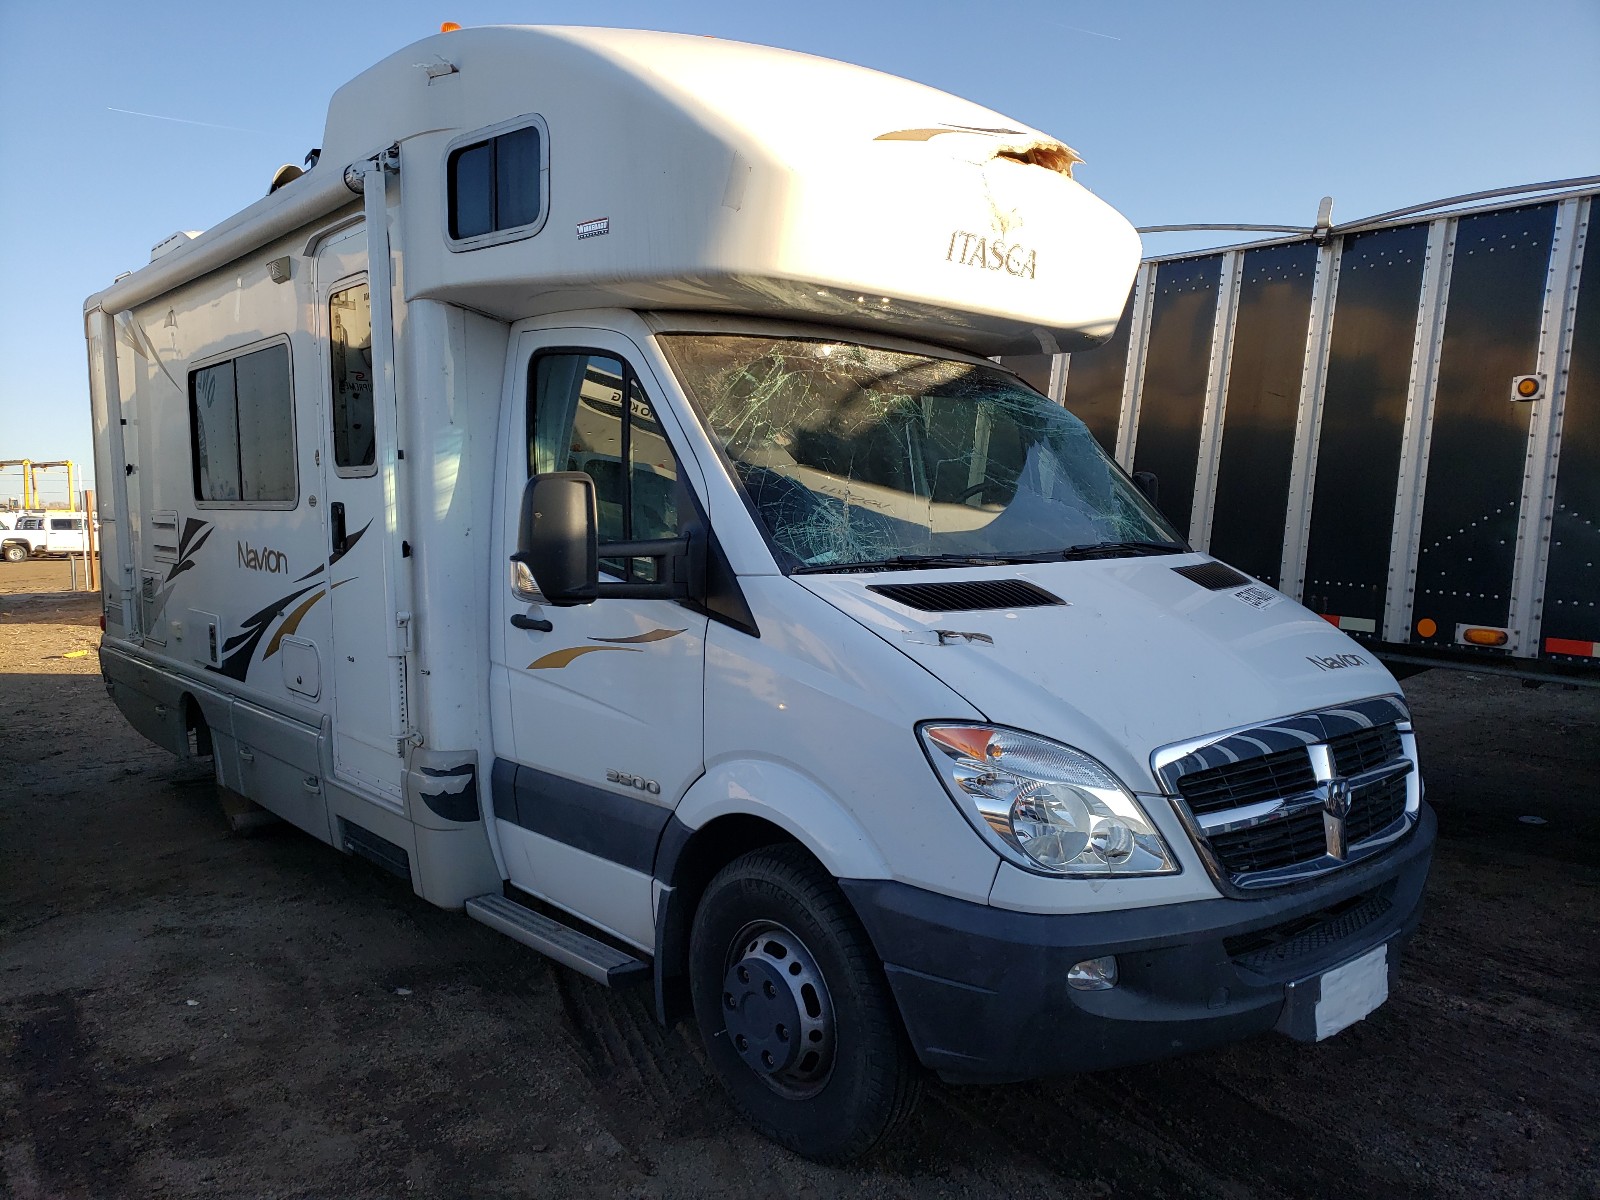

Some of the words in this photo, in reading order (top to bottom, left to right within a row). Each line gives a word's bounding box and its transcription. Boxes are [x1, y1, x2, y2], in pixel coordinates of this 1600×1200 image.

[946, 230, 1036, 279] ITASCA
[237, 540, 288, 575] Navion
[1306, 653, 1369, 671] Navion
[606, 768, 660, 794] 3500
